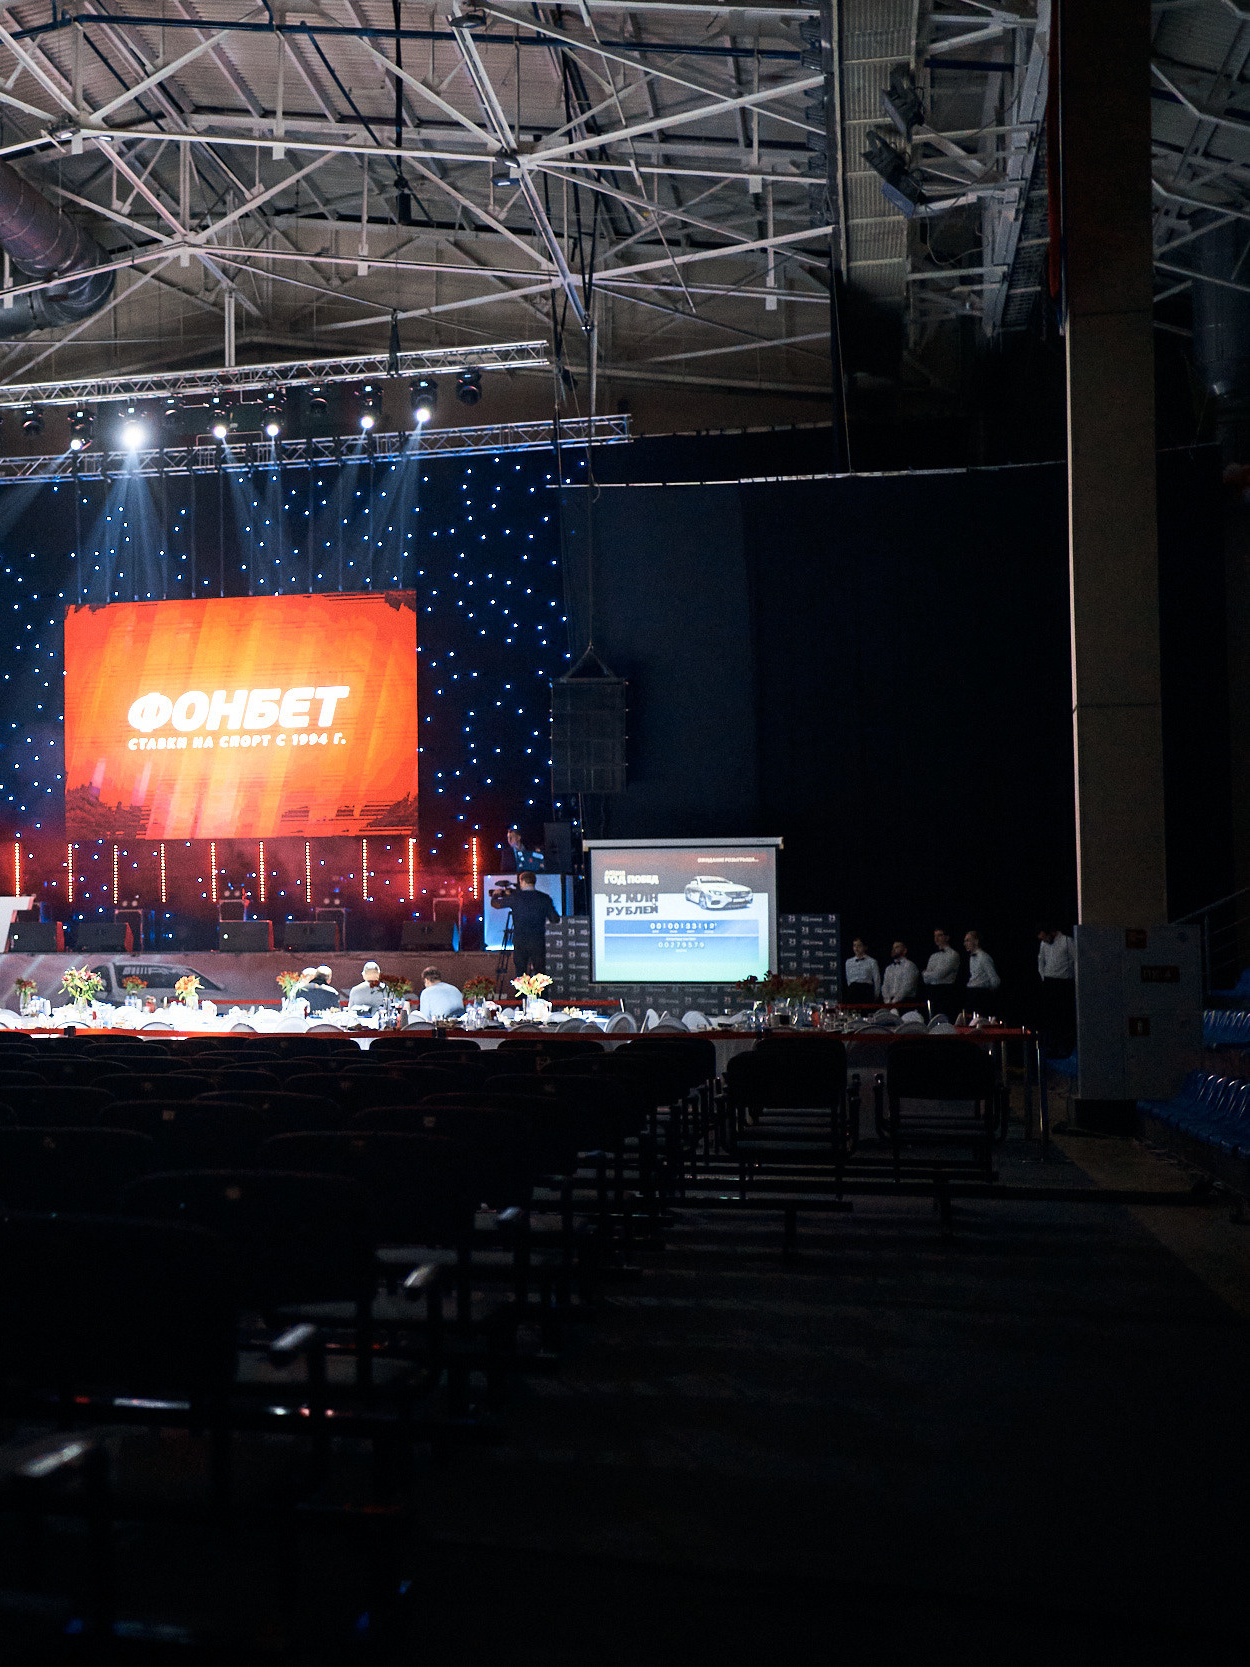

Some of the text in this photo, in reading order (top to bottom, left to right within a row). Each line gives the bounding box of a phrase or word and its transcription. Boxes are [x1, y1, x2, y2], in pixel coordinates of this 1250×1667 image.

[128, 686, 350, 733] ФОНБЕТ
[128, 737, 188, 750] СТАВКИ
[192, 736, 214, 749] НА
[219, 735, 272, 748] СПОРТ
[276, 734, 286, 747] С
[291, 733, 329, 746] 1994
[604, 874, 626, 885] ГОД
[607, 893, 659, 903] 12 МЛН
[606, 904, 659, 916] РУБЛЕЙ
